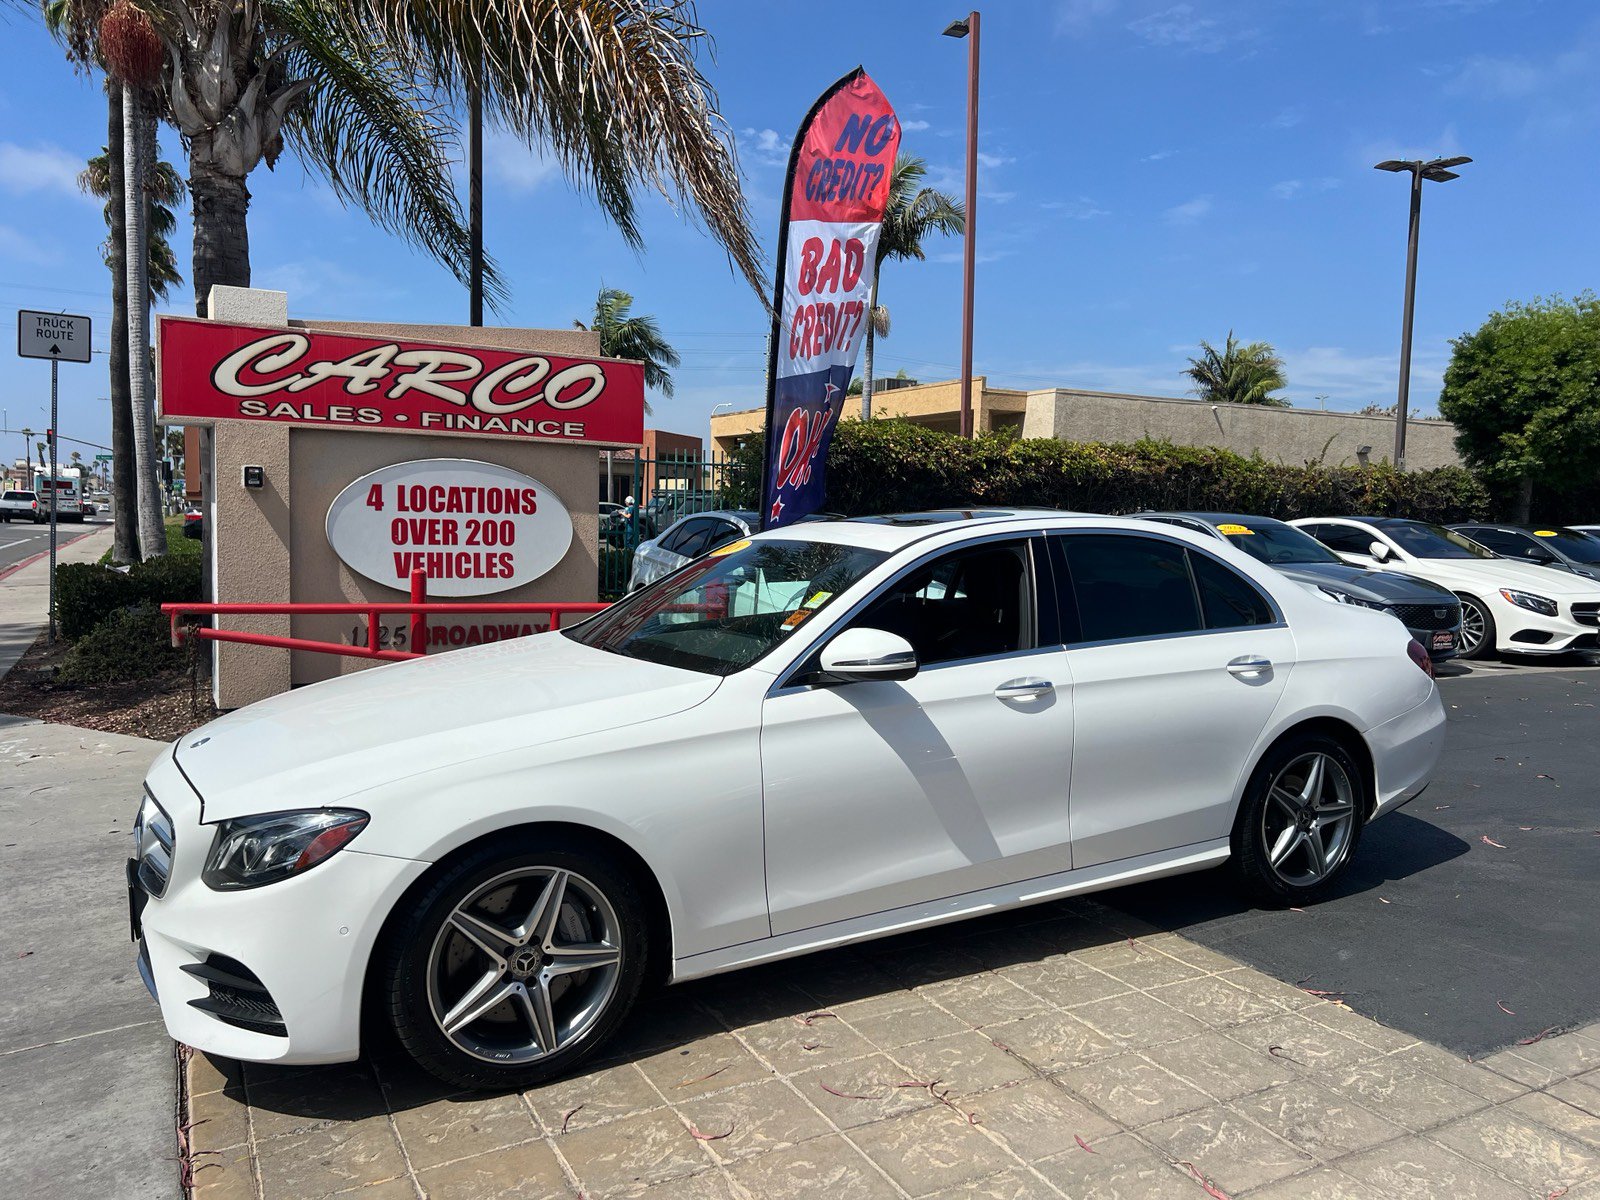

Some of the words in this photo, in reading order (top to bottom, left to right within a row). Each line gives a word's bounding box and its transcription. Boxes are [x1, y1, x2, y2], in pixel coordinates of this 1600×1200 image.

[834, 113, 896, 157] NO
[805, 158, 885, 203] CREDIT?
[798, 236, 864, 296] BAD
[36, 316, 75, 330] TRUCK
[36, 328, 74, 341] ROUTE
[789, 300, 864, 361] CREDIT?
[211, 332, 607, 415] CARCO
[239, 399, 383, 425] SALES
[420, 412, 586, 437] FINANCE
[366, 484, 384, 511] 4
[397, 484, 537, 515] LOCATIONS
[391, 517, 459, 546] OVER
[465, 519, 515, 547] 200
[393, 551, 515, 579] VEHICLES
